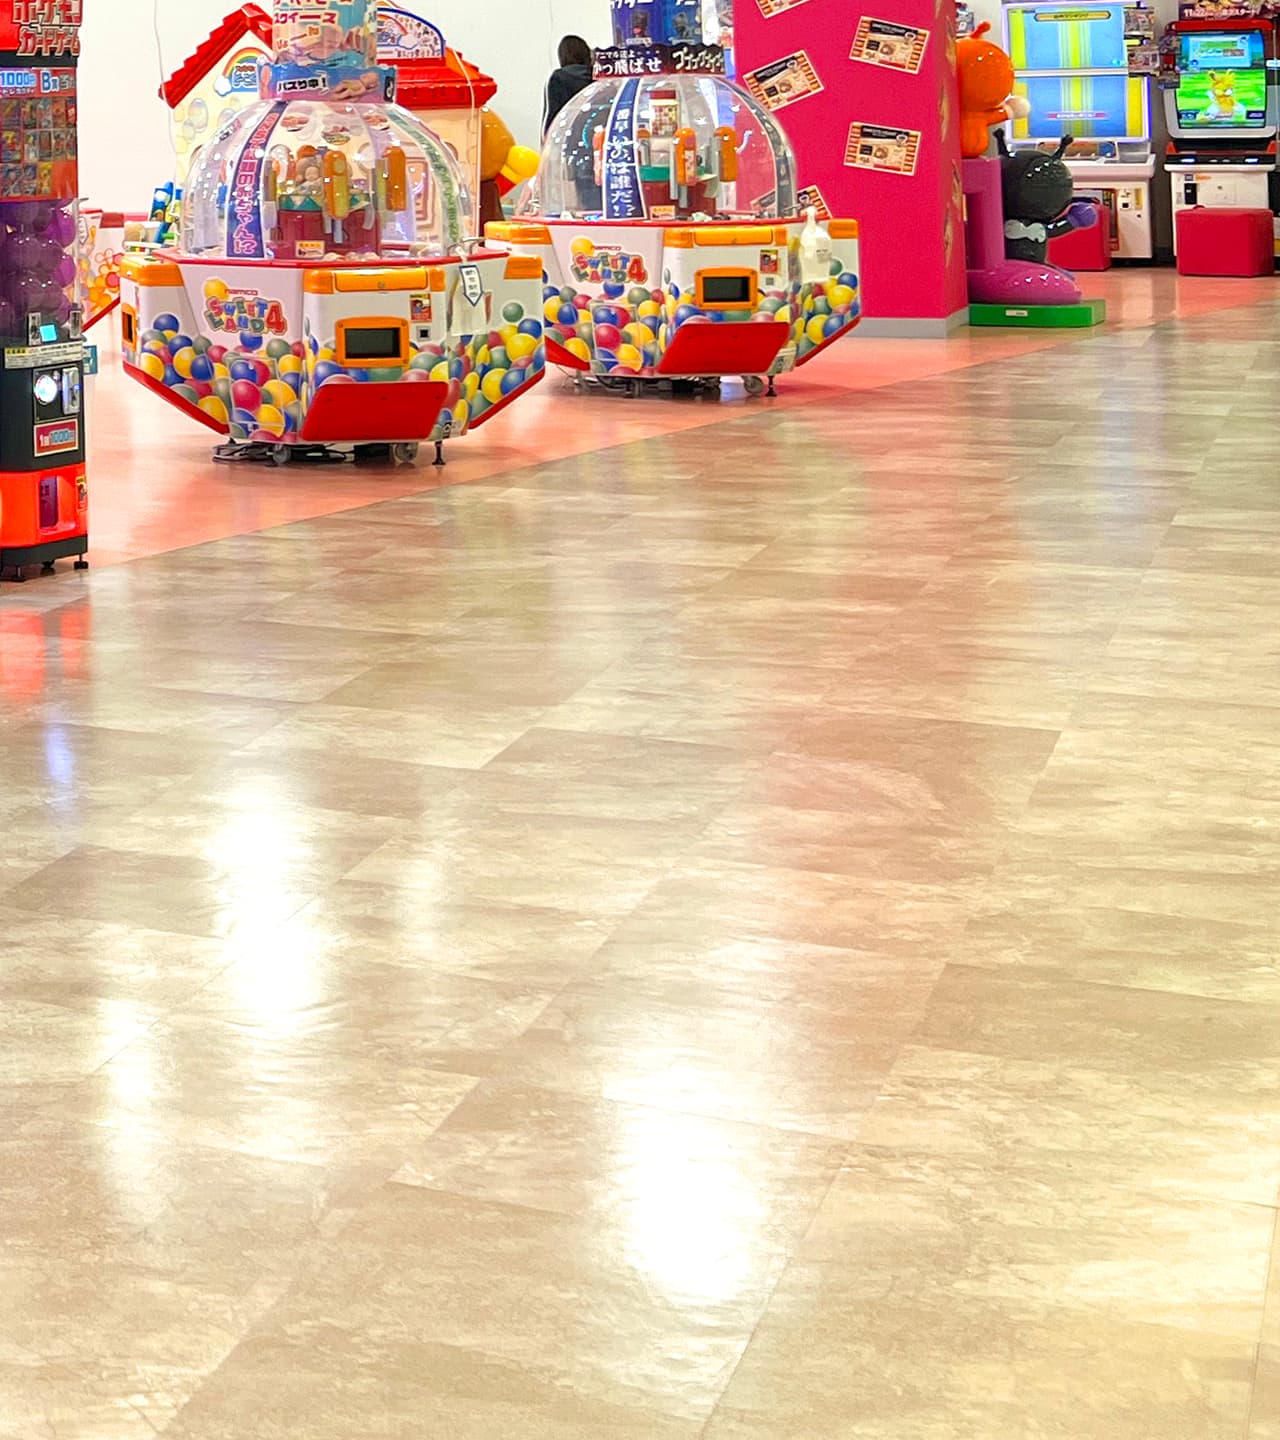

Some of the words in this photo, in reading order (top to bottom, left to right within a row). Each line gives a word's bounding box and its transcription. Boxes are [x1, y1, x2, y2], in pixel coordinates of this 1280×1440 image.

[17, 26, 81, 57] カードゲーム
[0, 71, 37, 87] 1000円
[204, 311, 265, 334] LAND
[206, 297, 268, 317] SWEET
[265, 303, 287, 335] 4
